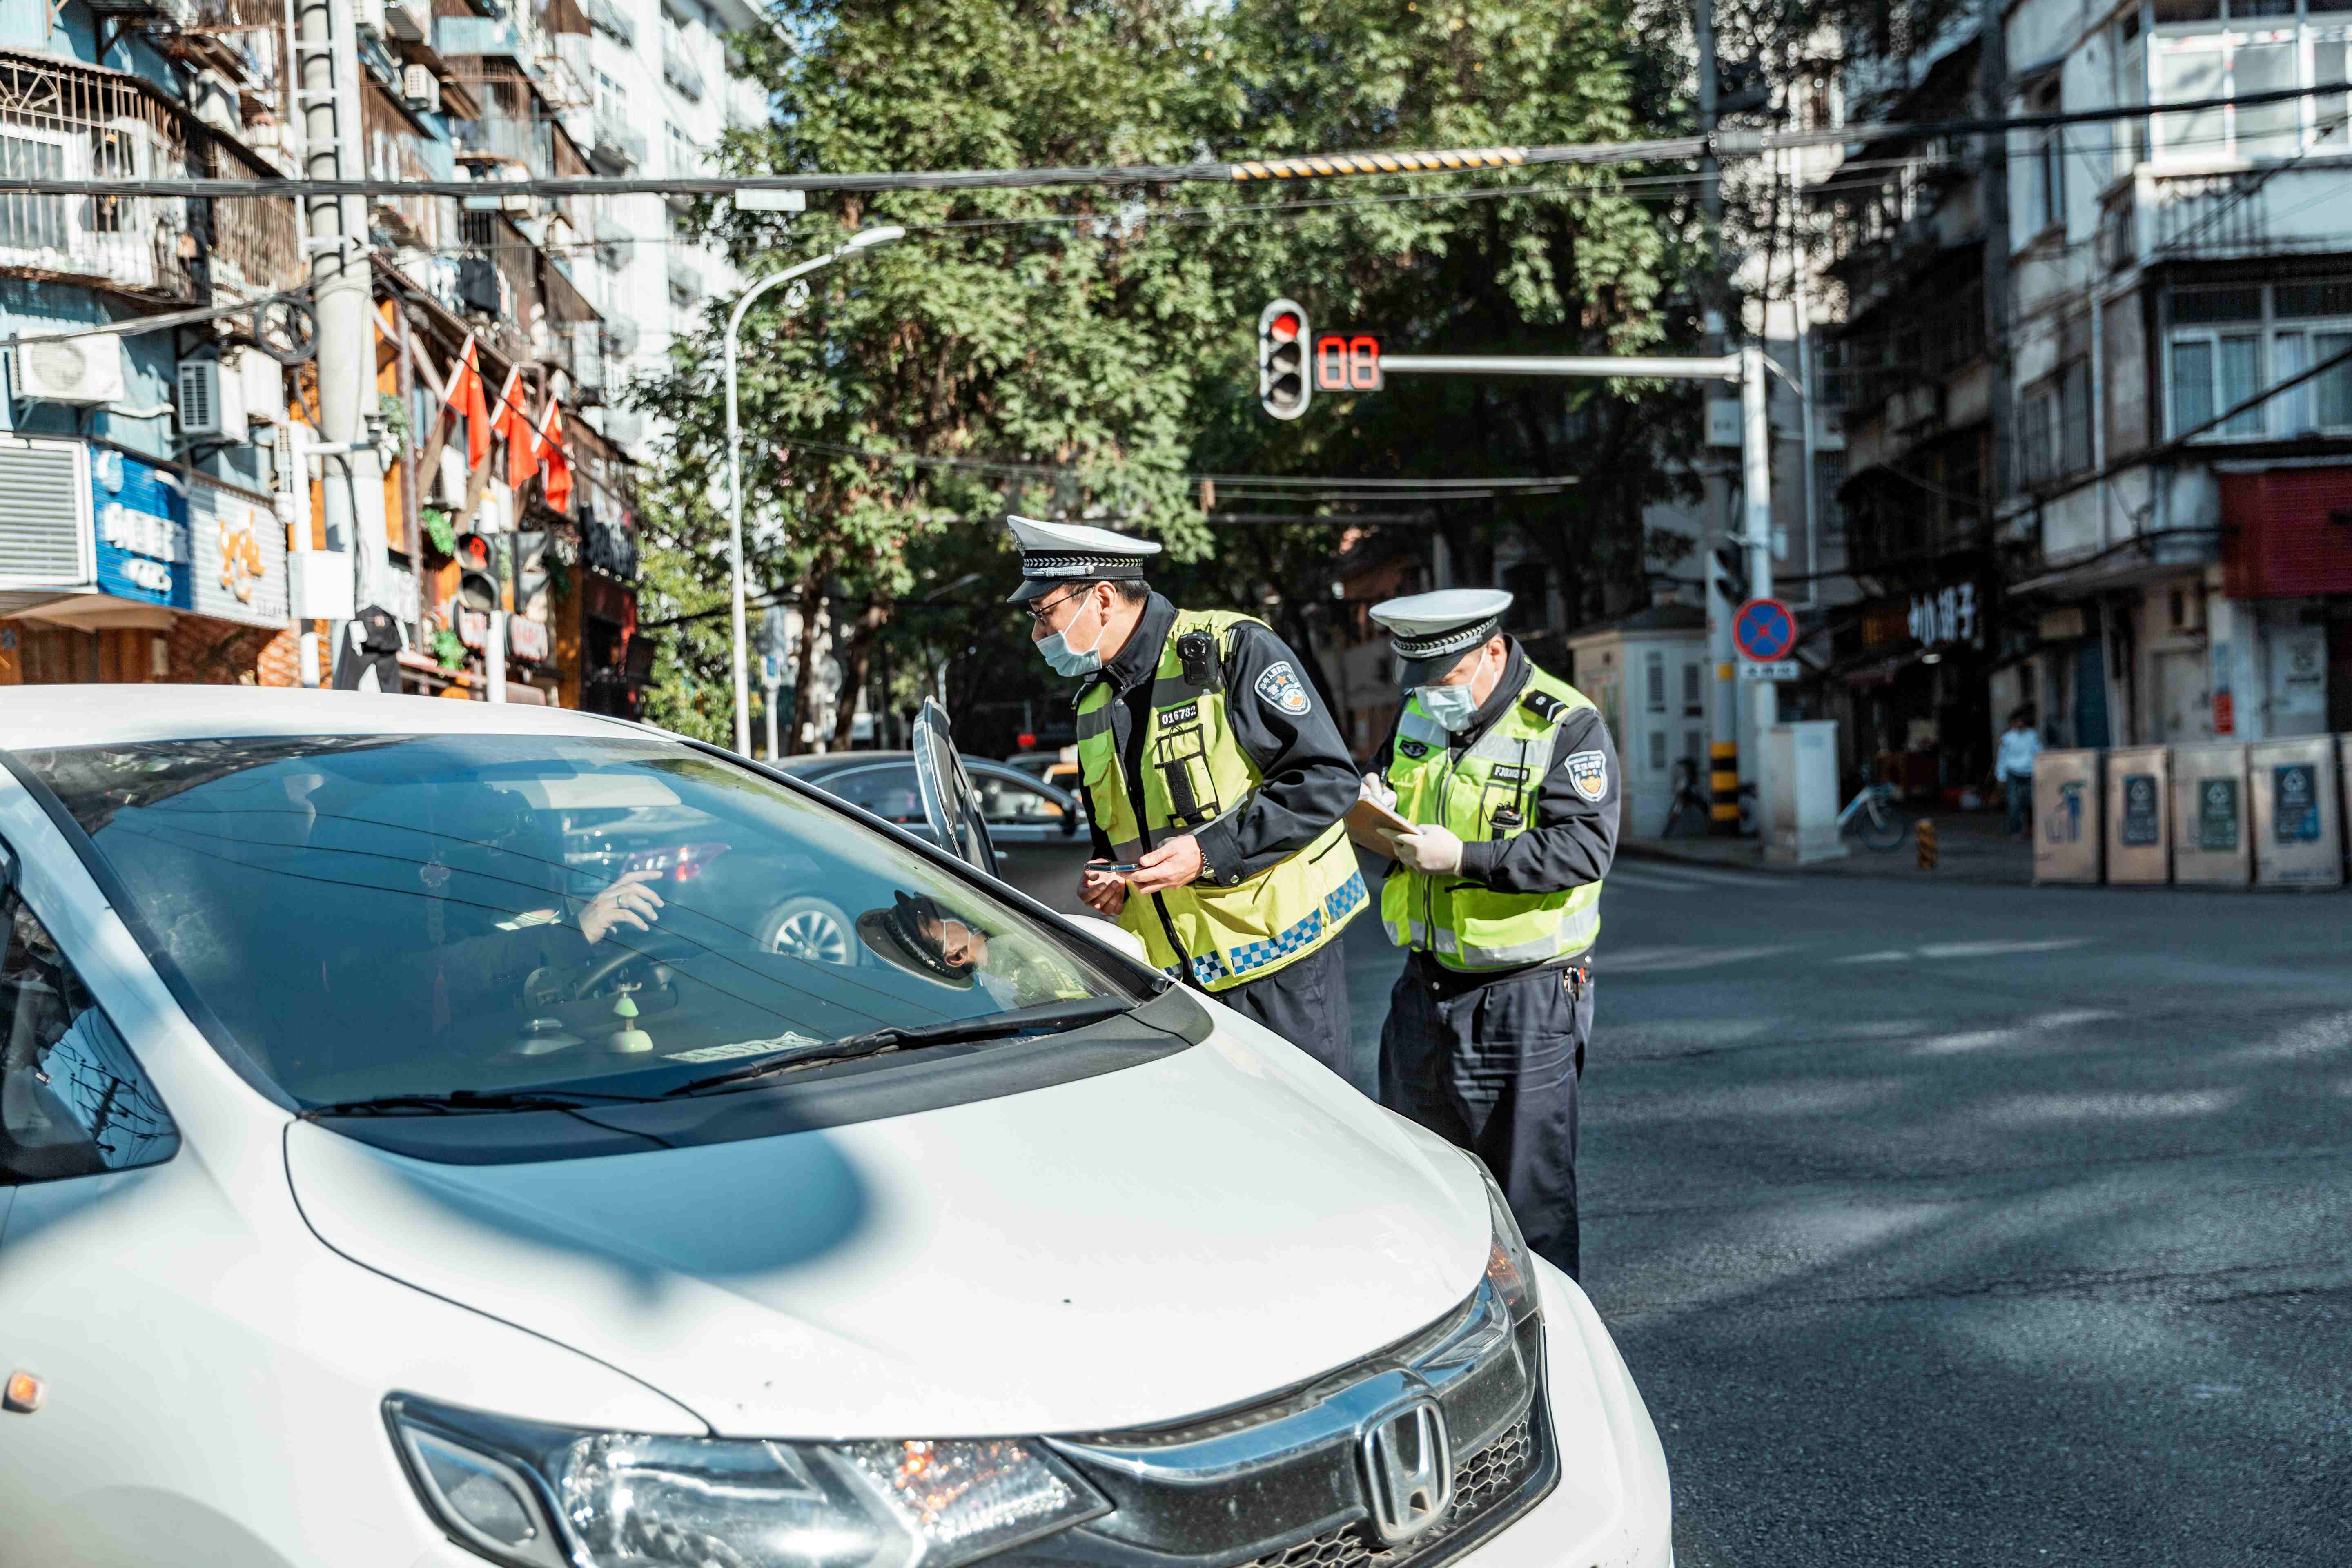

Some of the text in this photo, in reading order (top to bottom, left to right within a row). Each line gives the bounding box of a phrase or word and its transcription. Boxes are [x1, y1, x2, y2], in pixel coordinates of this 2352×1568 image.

[1318, 336, 1379, 389] 08
[1259, 665, 1292, 690] 中华人民共
[1162, 705, 1196, 725] 016782
